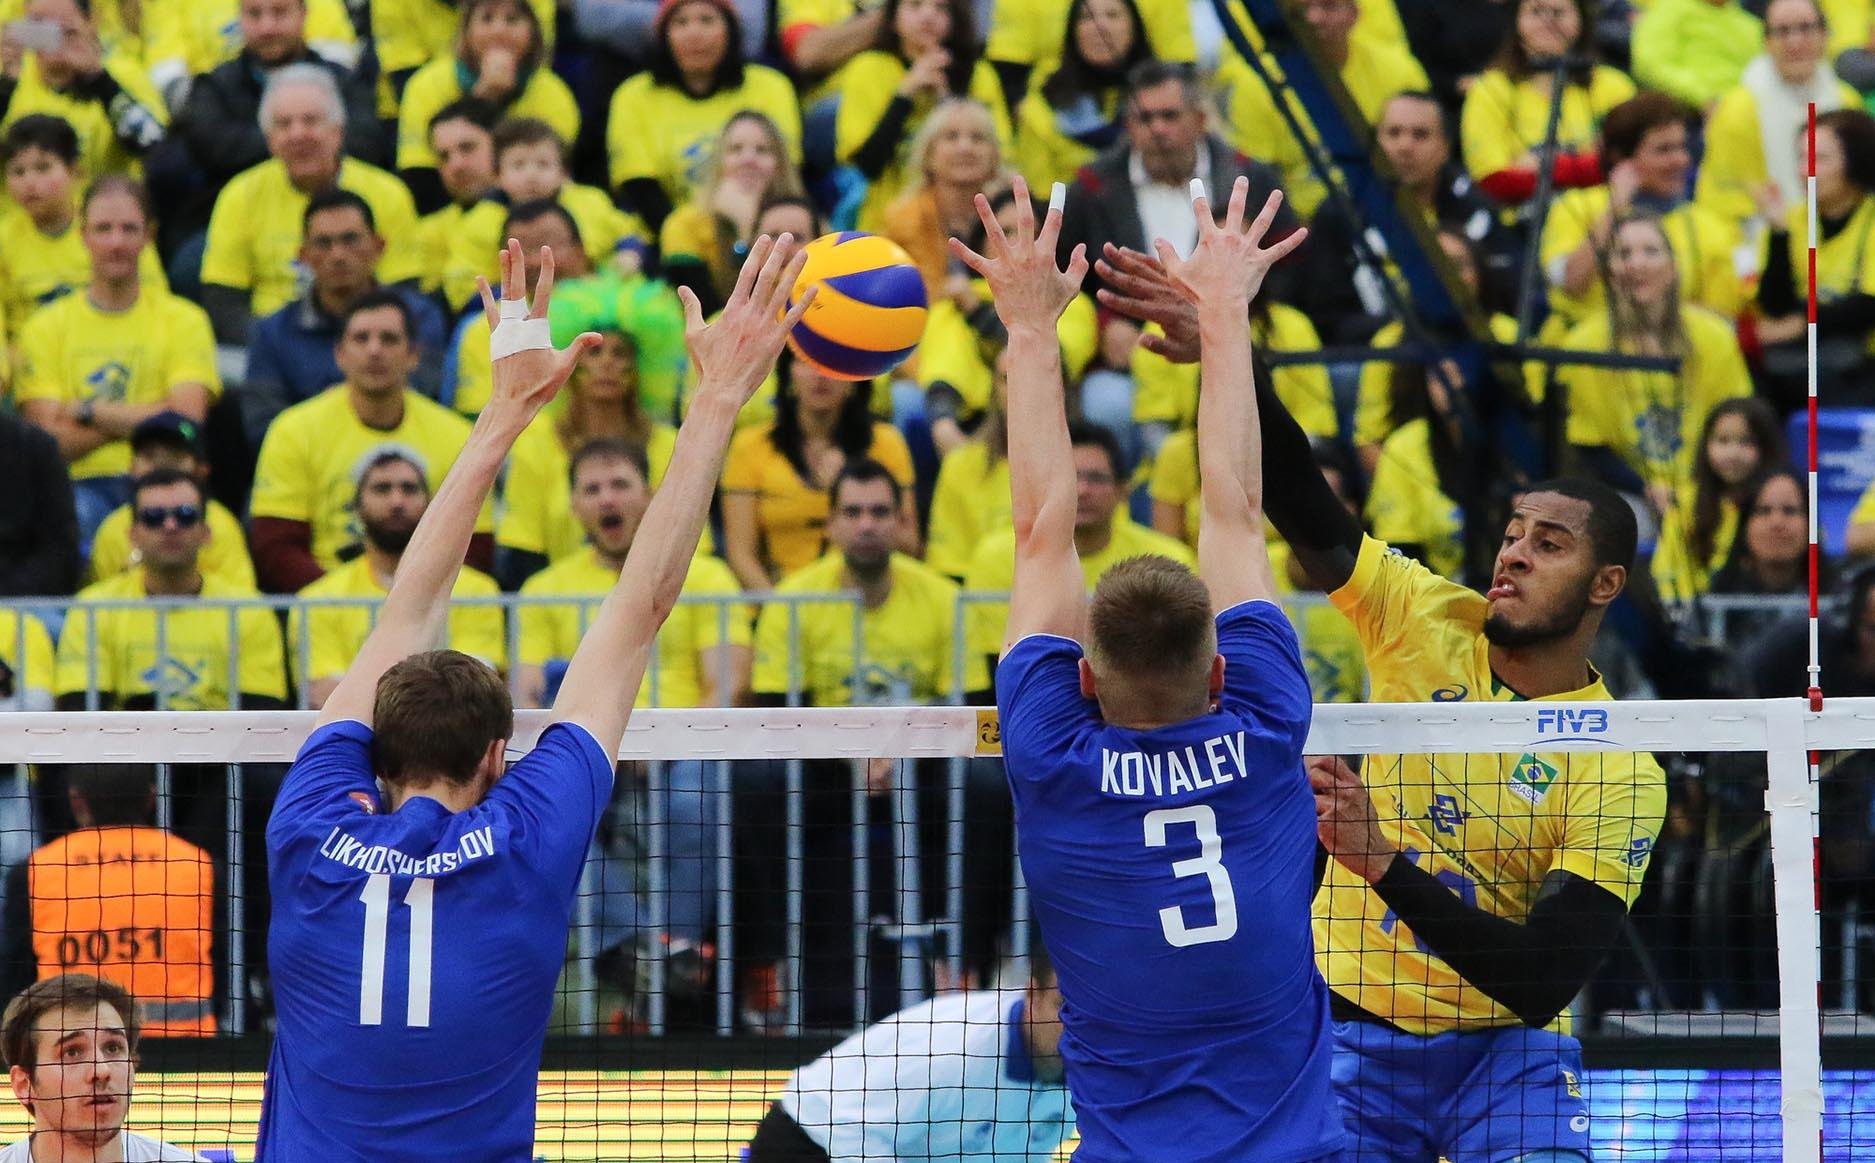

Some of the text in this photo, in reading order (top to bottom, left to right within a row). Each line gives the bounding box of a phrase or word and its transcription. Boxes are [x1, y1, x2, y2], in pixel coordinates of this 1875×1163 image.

[1538, 709, 1608, 733] FIVB
[1101, 731, 1247, 796] KOVALEV
[319, 826, 494, 875] LIKHOSHERSOV
[1143, 804, 1238, 947] 3
[58, 926, 163, 967] 0051
[359, 873, 434, 1027] 11
